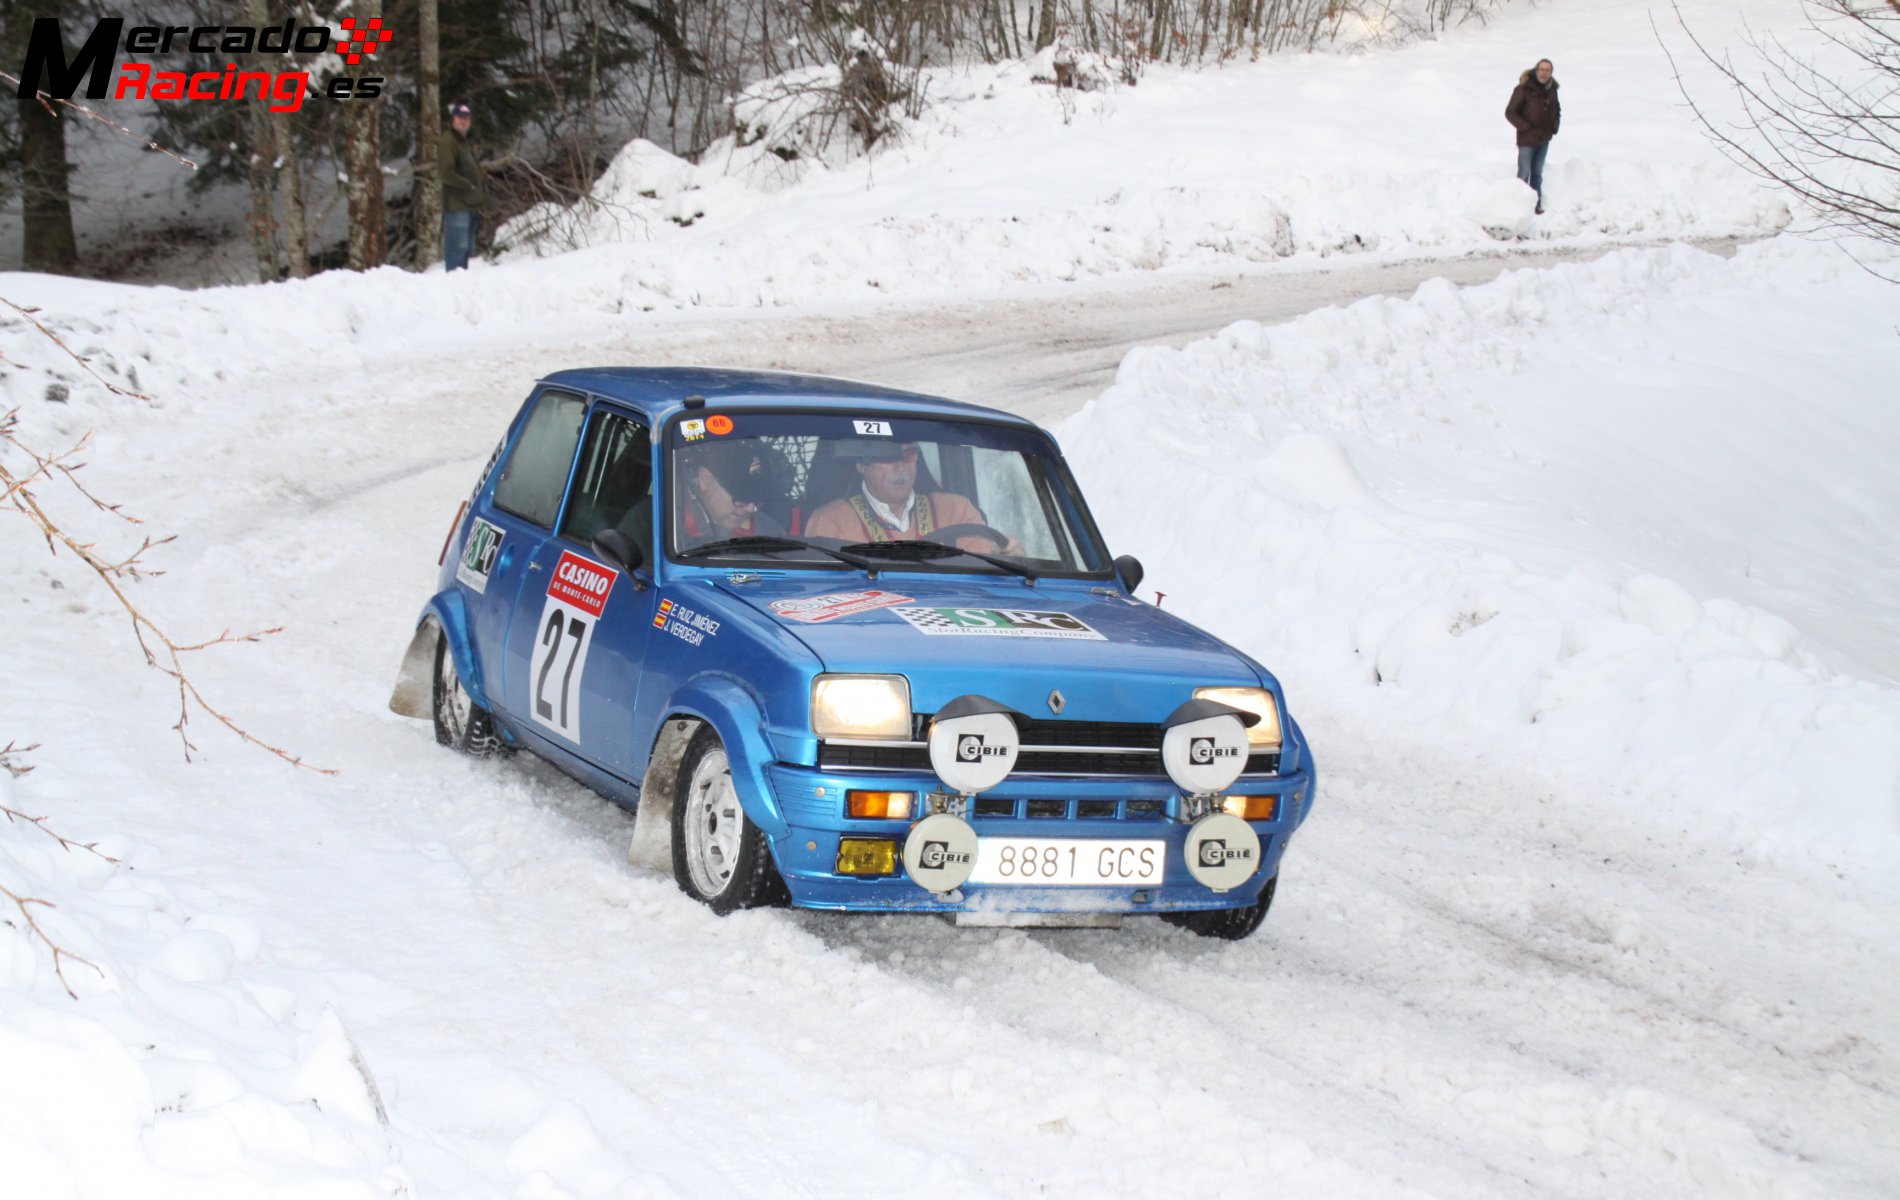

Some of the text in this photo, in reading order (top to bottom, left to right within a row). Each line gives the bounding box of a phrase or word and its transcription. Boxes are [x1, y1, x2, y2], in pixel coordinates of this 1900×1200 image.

[863, 422, 881, 434] 27
[558, 561, 609, 595] CASINO
[553, 581, 601, 608] DE MONTE-CARLO
[670, 620, 705, 647] VERDEGAY
[676, 606, 695, 624] RUIZ
[690, 614, 721, 636] JIMÉNEZ
[954, 609, 1084, 631] SRC
[536, 608, 587, 730] 27
[998, 846, 1155, 878] 8881 GCS
